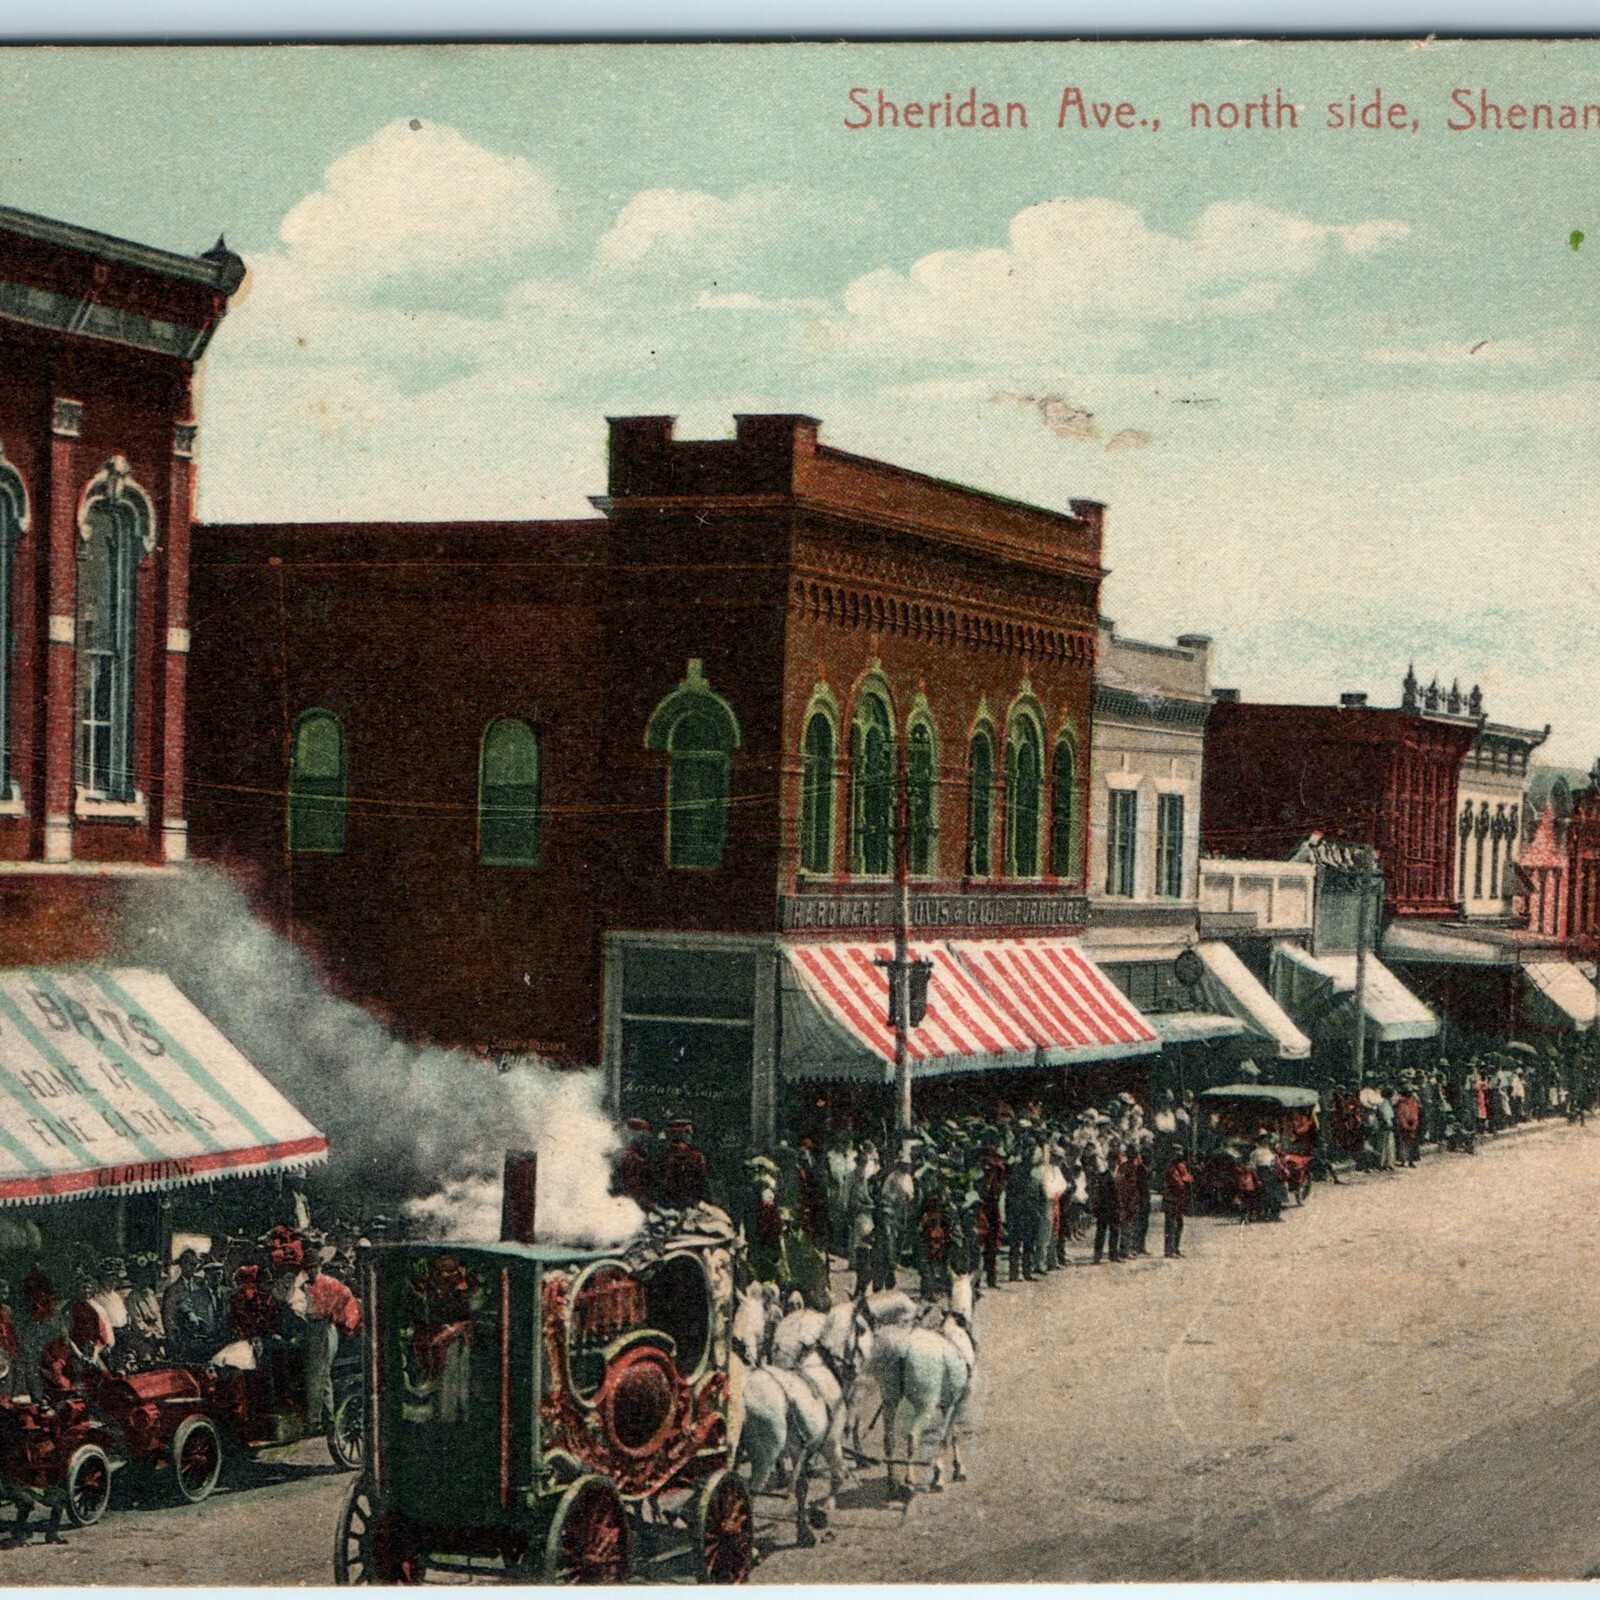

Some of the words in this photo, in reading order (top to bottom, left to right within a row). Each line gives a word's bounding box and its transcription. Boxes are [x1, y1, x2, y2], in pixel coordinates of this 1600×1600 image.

[1014, 900, 1082, 925] FURNITURE
[17, 1063, 98, 1100] HOME
[26, 1115, 98, 1148] FINE
[97, 1158, 194, 1187] CLOTHING
